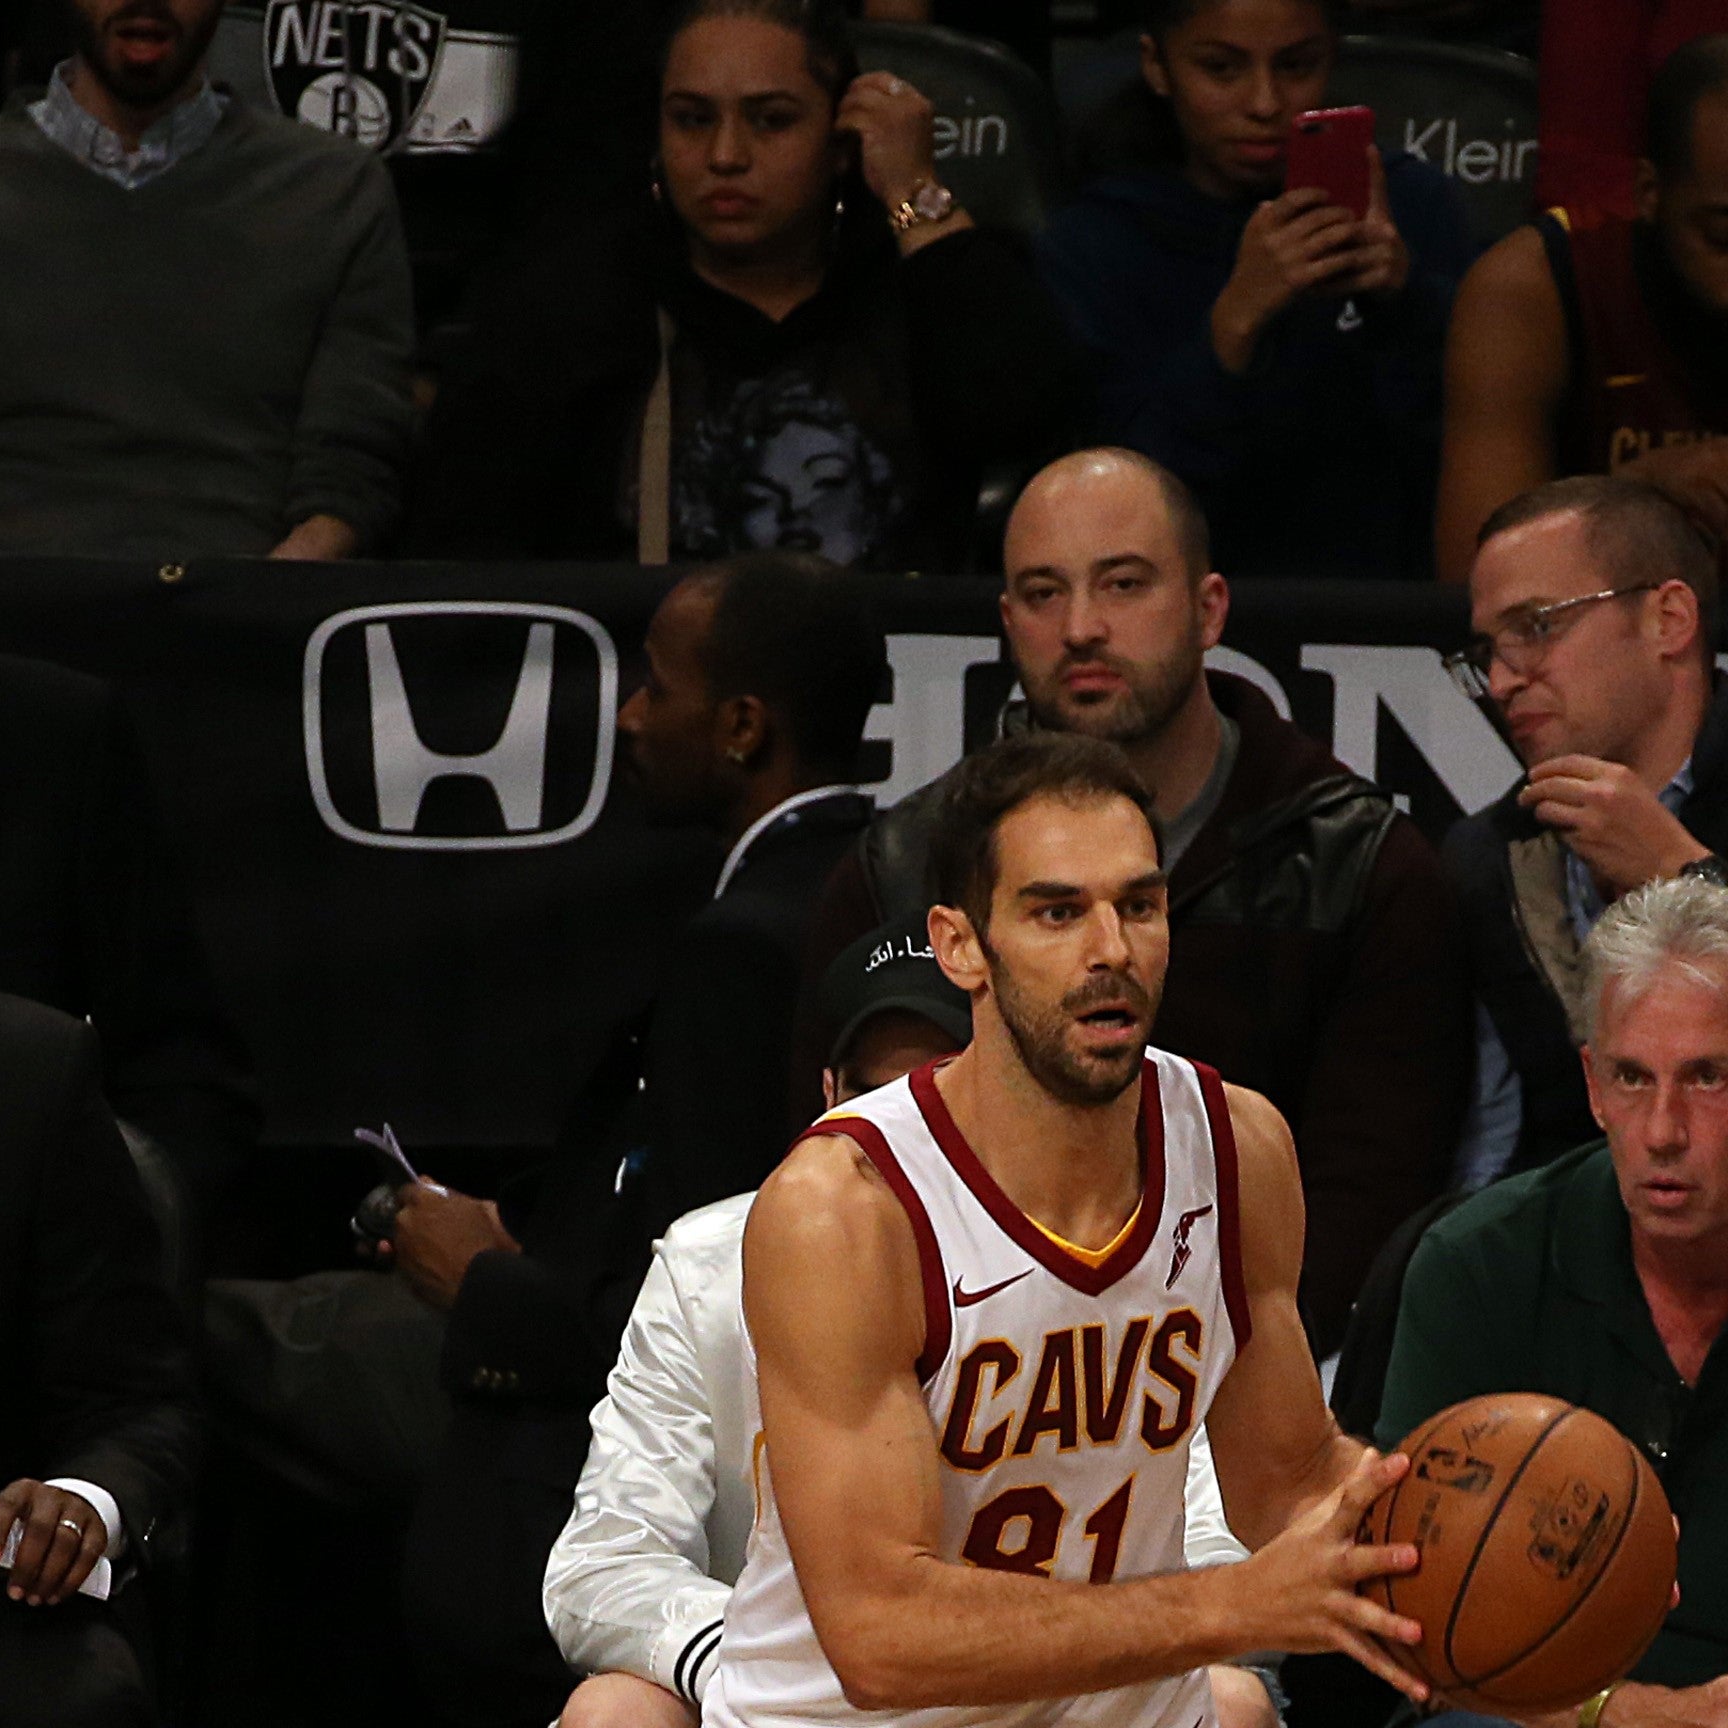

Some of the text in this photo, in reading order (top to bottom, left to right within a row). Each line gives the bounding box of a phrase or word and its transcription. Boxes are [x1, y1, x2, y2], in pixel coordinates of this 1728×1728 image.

[272, 2, 432, 83] NETS
[933, 96, 1007, 160] ein
[939, 1306, 1203, 1476] CAVS
